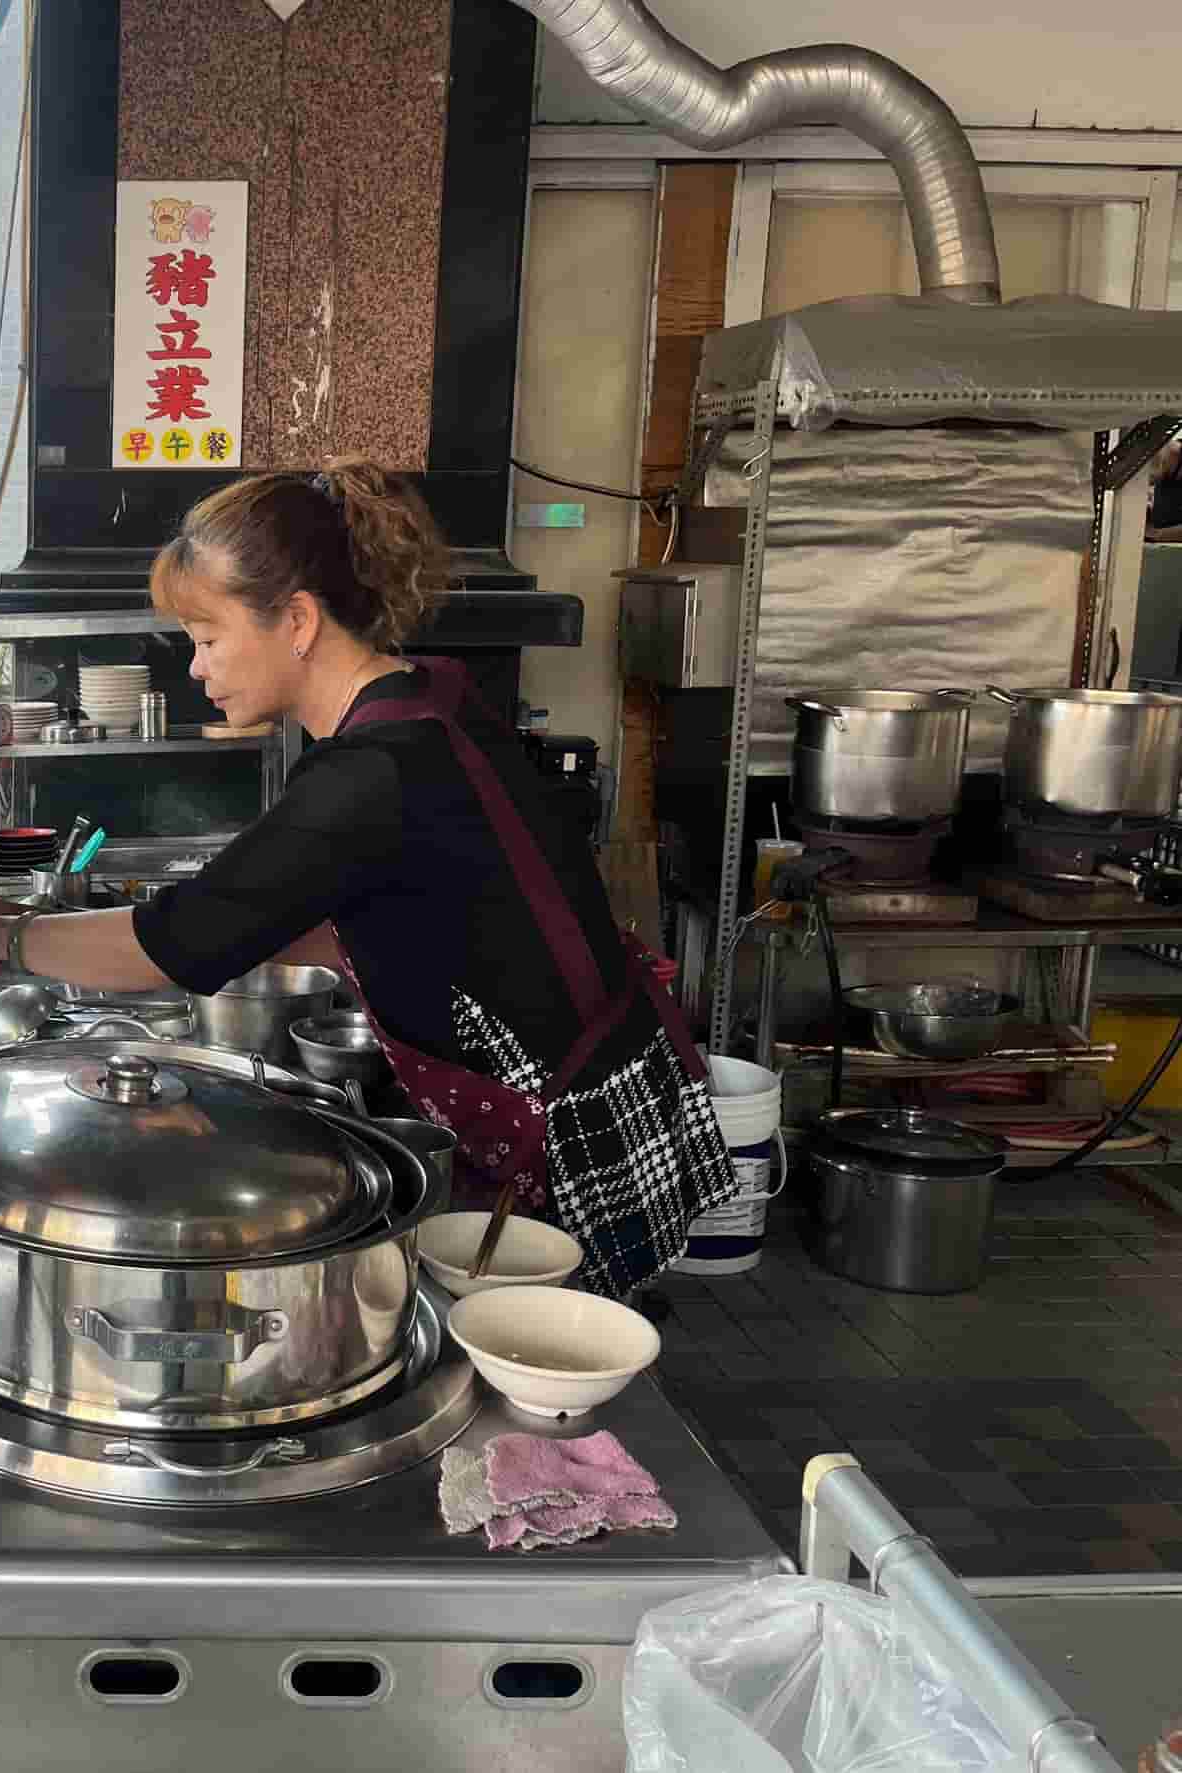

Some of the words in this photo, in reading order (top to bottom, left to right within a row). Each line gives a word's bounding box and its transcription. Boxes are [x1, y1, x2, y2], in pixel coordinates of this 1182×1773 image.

[146, 249, 216, 422] 豬立業
[125, 431, 227, 460] 早午餐
